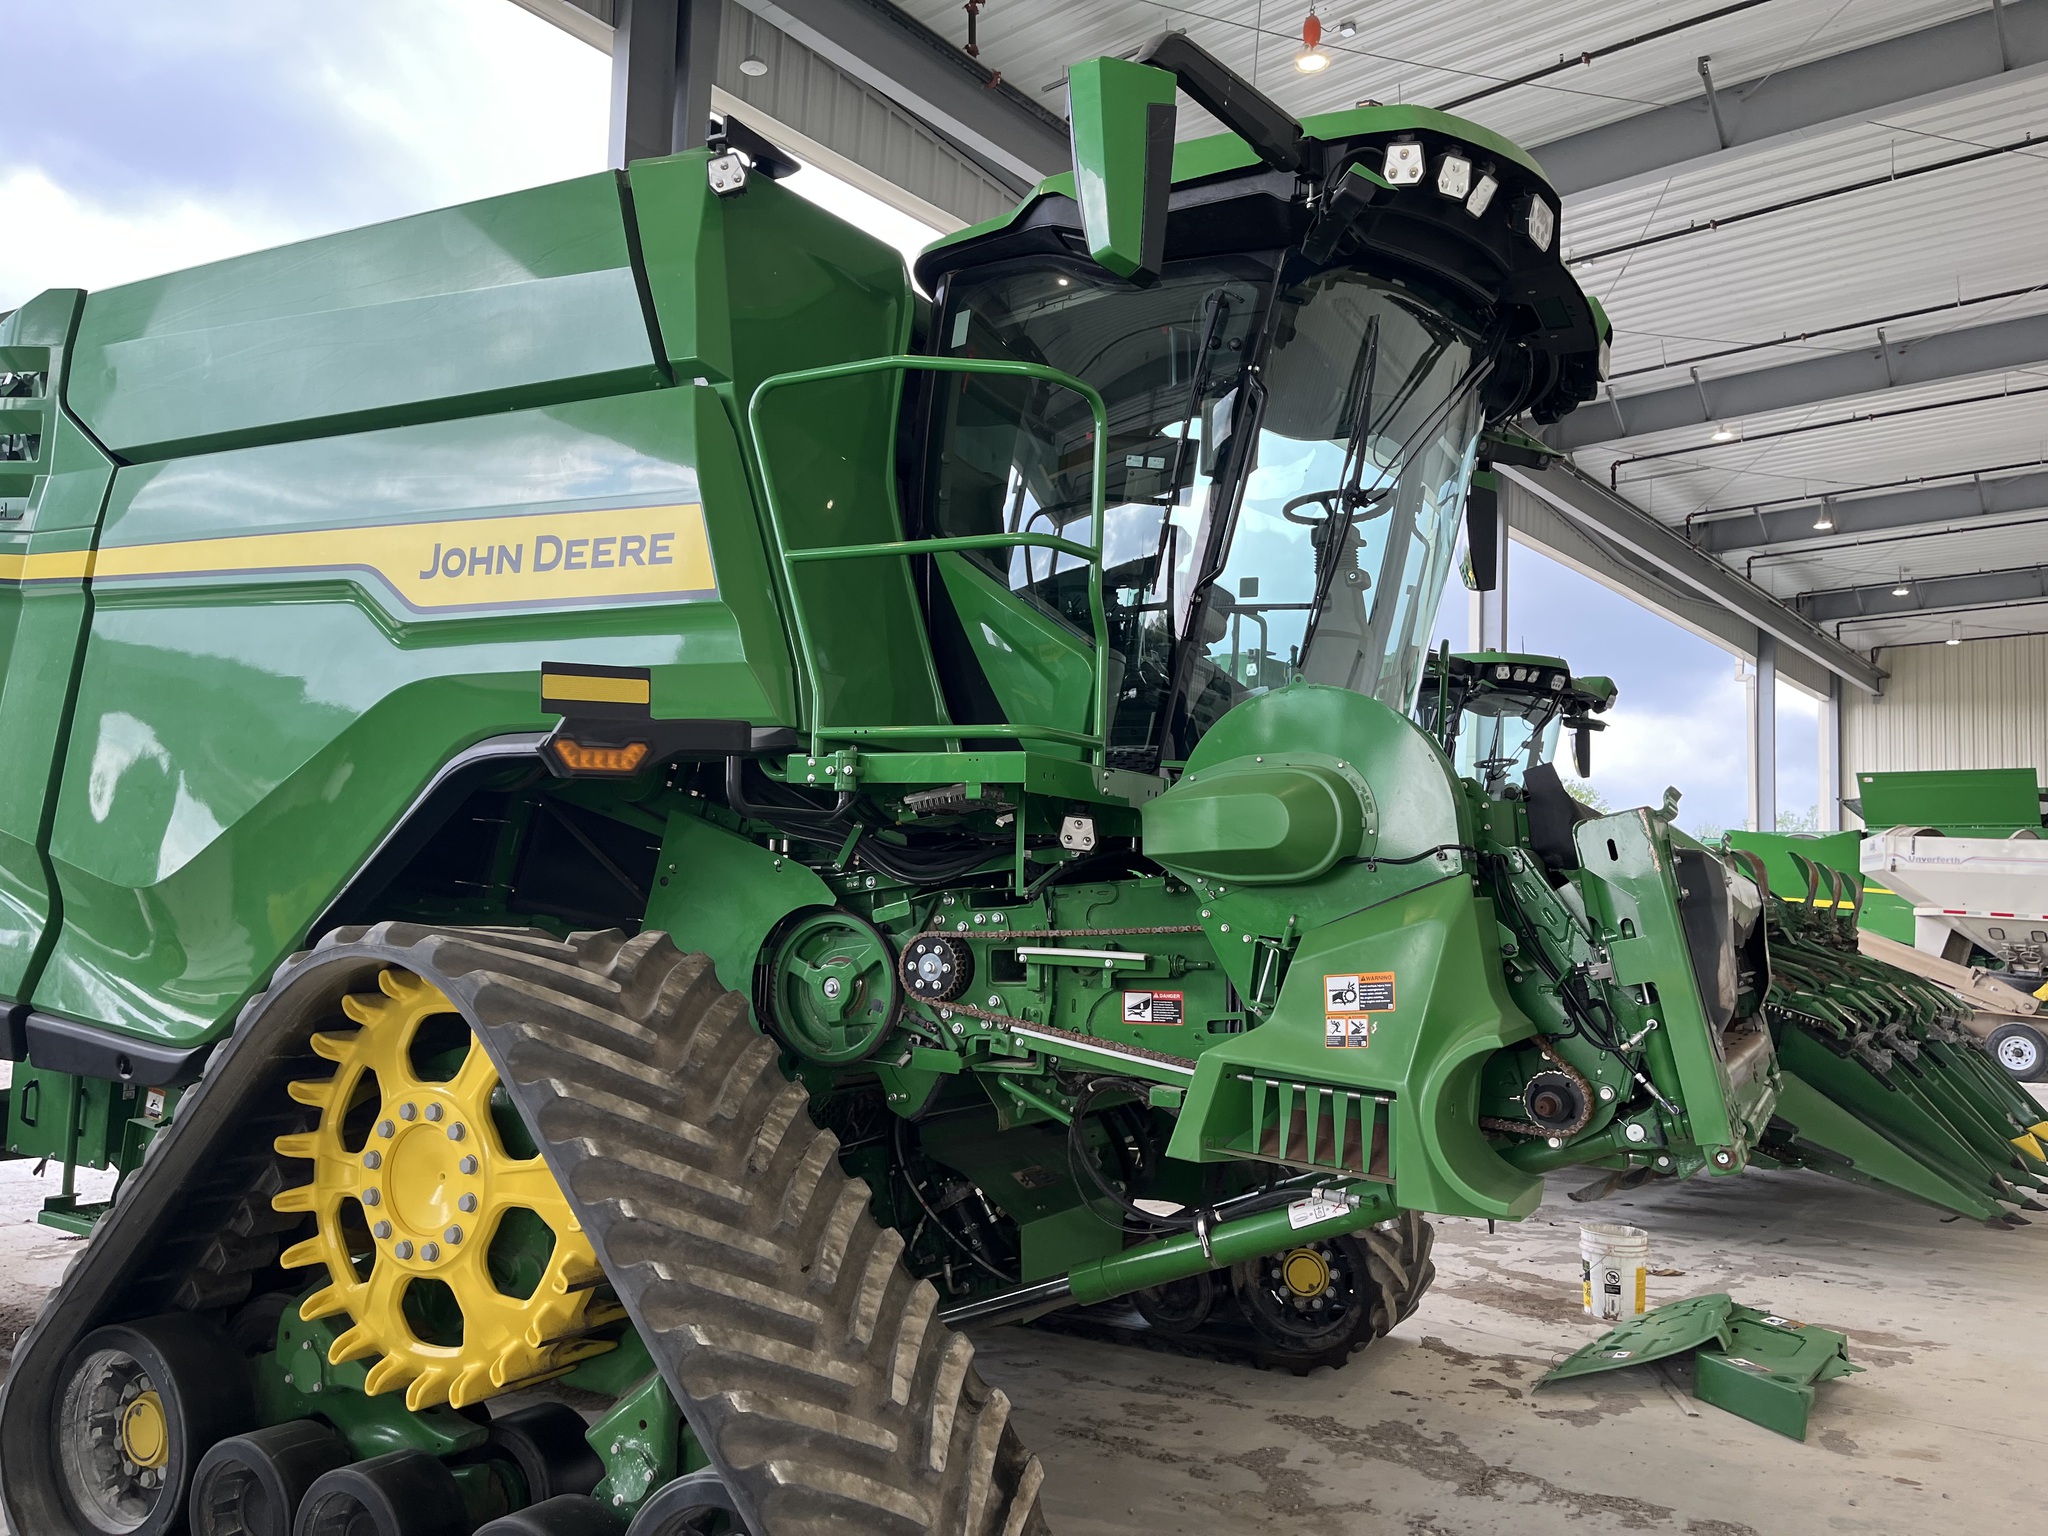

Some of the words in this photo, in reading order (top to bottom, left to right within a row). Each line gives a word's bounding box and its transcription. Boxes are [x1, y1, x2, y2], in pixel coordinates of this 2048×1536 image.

[419, 543, 523, 579] JOHN
[533, 532, 675, 572] DEERE
[1908, 855, 1961, 865] Unverferth
